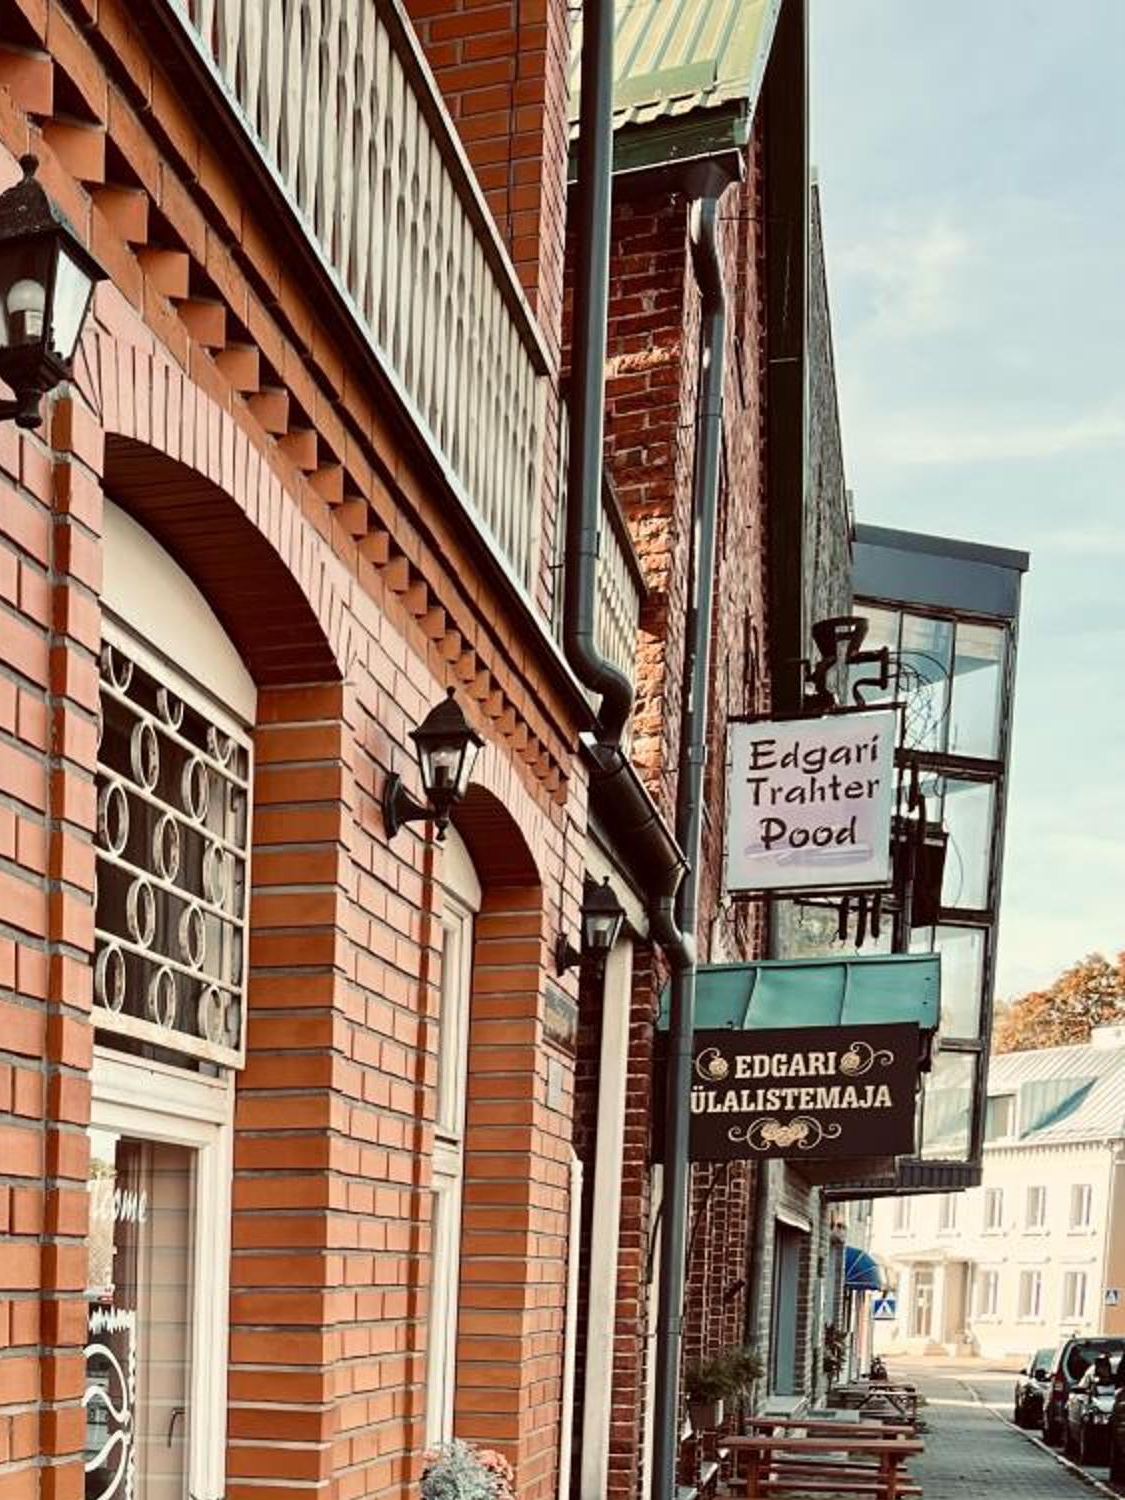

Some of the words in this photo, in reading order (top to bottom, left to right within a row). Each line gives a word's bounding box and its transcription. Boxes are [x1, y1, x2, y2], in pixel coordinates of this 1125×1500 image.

[749, 735, 879, 773] Edgari
[746, 774, 880, 806] Trahter
[759, 815, 857, 850] Pood
[734, 1052, 838, 1079] EDGARI
[690, 1084, 893, 1114] ÜLALISTEMAJA
